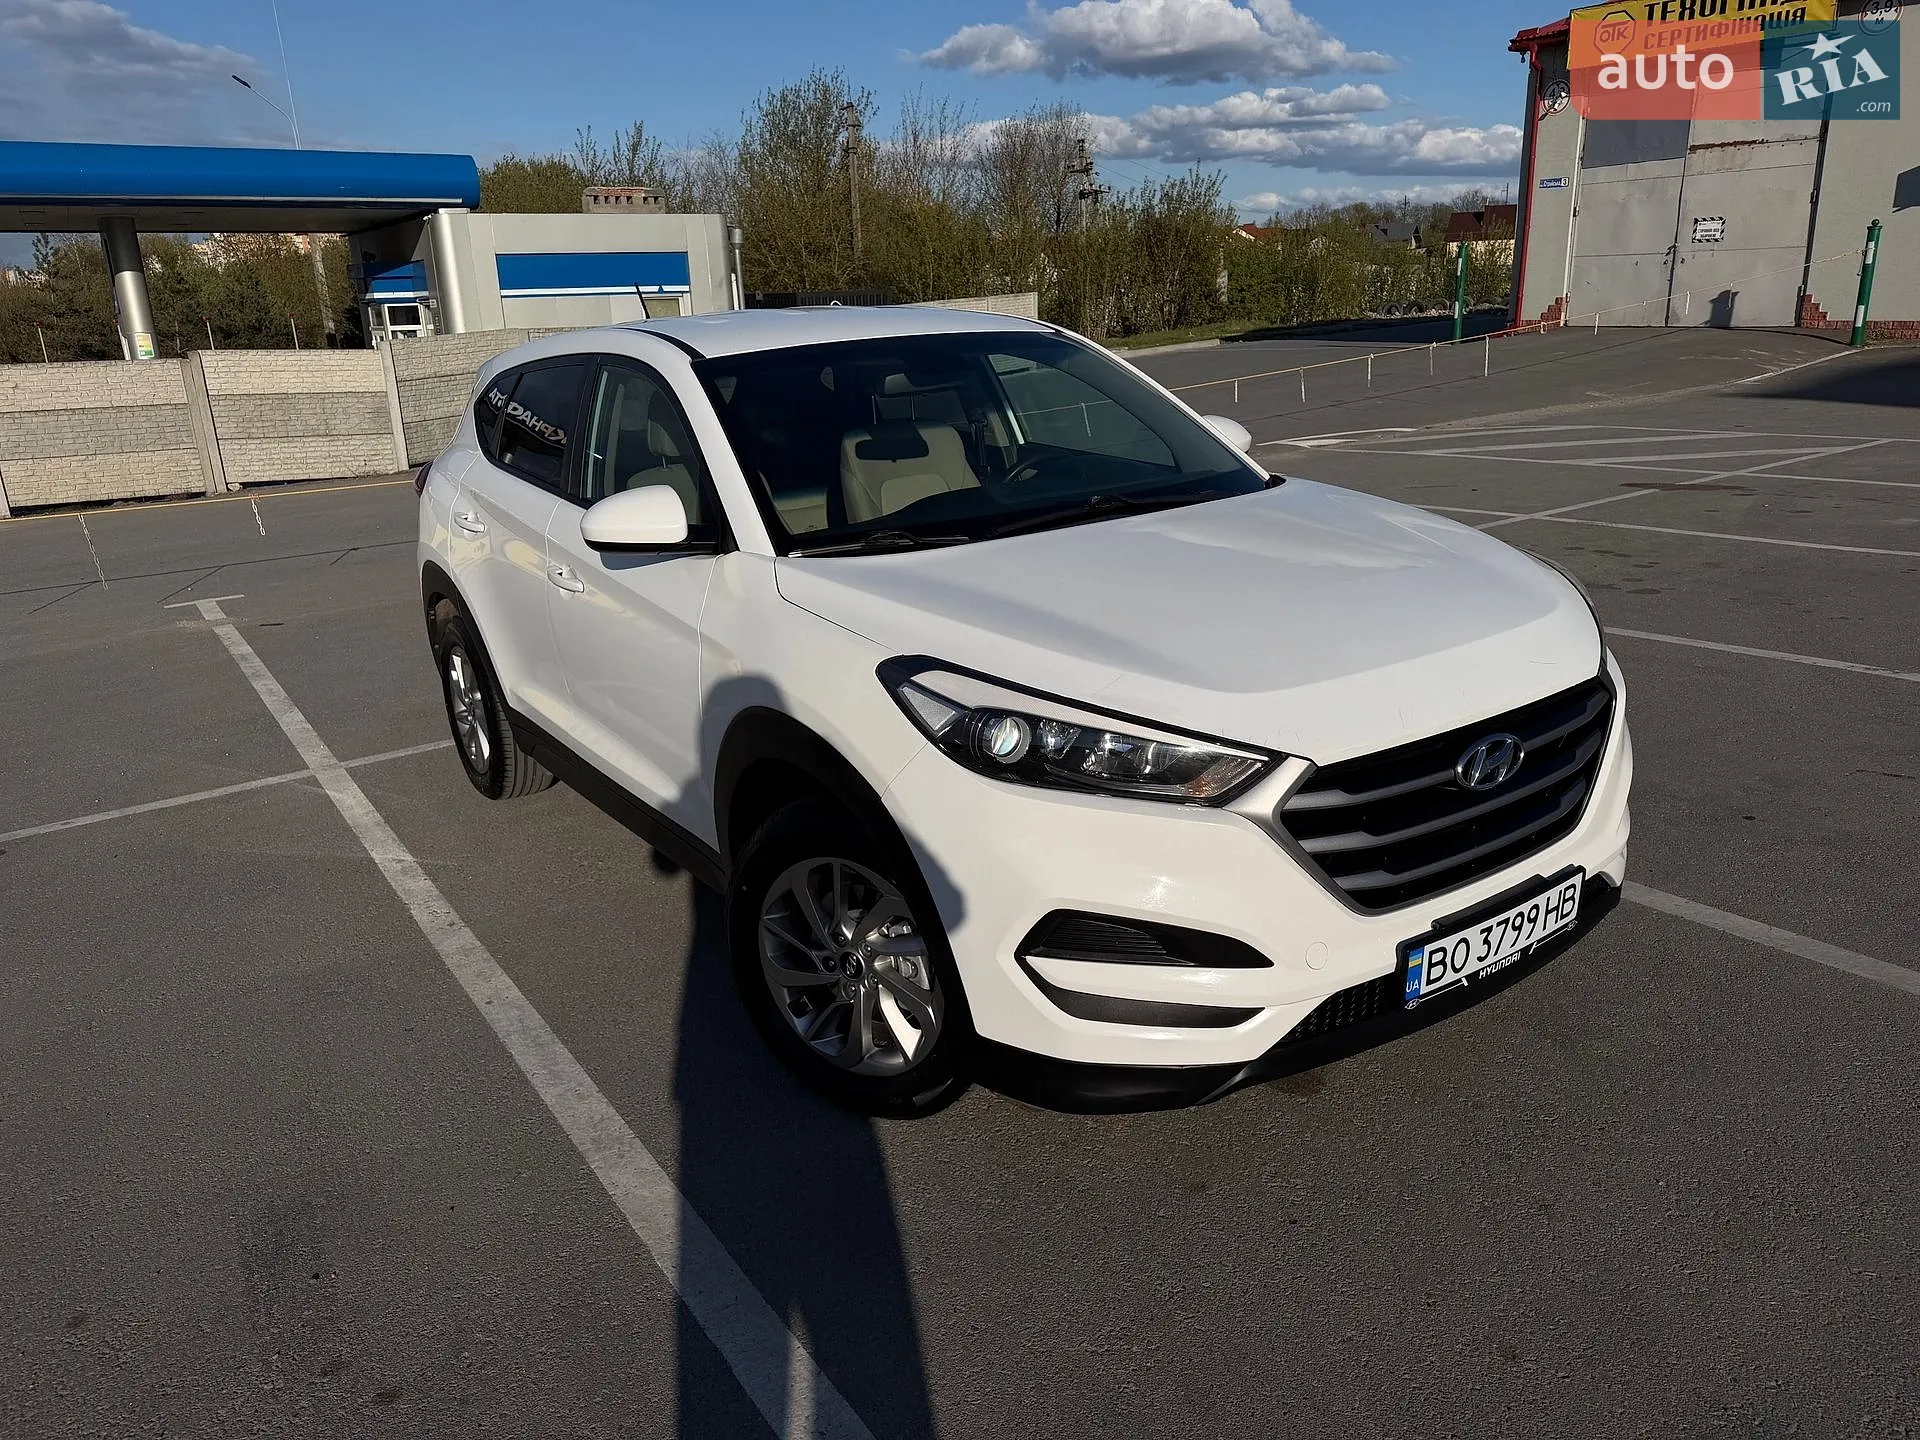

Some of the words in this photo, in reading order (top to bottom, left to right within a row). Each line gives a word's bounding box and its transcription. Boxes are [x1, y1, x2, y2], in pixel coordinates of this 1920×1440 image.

[1599, 20, 1631, 43] ОТК
[1643, 6, 1807, 50] СЕРТИФІКАЦІЯ
[1425, 937, 1470, 986] BO
[1476, 904, 1540, 963] 3799
[1543, 883, 1577, 931] HB
[1479, 953, 1521, 979] HYUNDAI
[1406, 979, 1420, 992] UA
